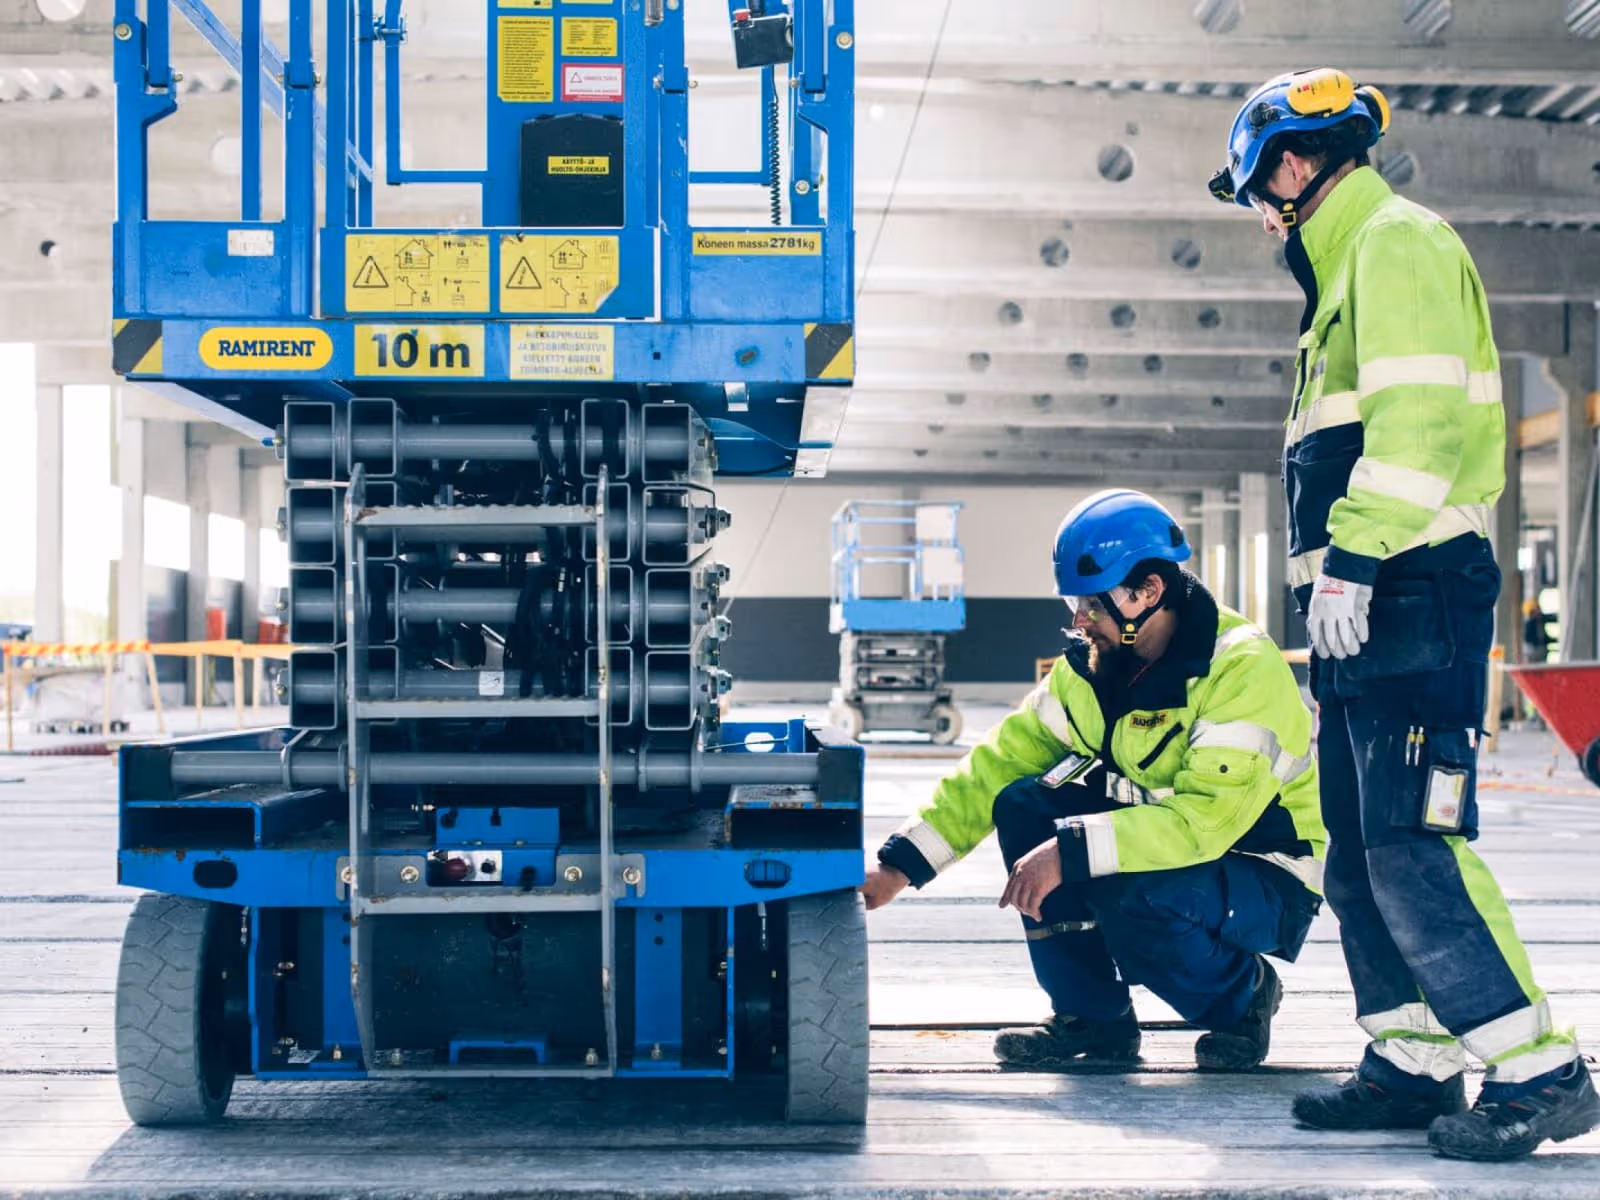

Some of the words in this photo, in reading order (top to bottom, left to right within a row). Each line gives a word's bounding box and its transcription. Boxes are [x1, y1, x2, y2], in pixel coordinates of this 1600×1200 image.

[697, 238, 735, 249] Koneen
[736, 239, 768, 249] massa
[769, 237, 815, 252] 2781kg
[217, 339, 317, 357] RAMIRENT
[371, 332, 419, 369] 10
[428, 342, 471, 369] m
